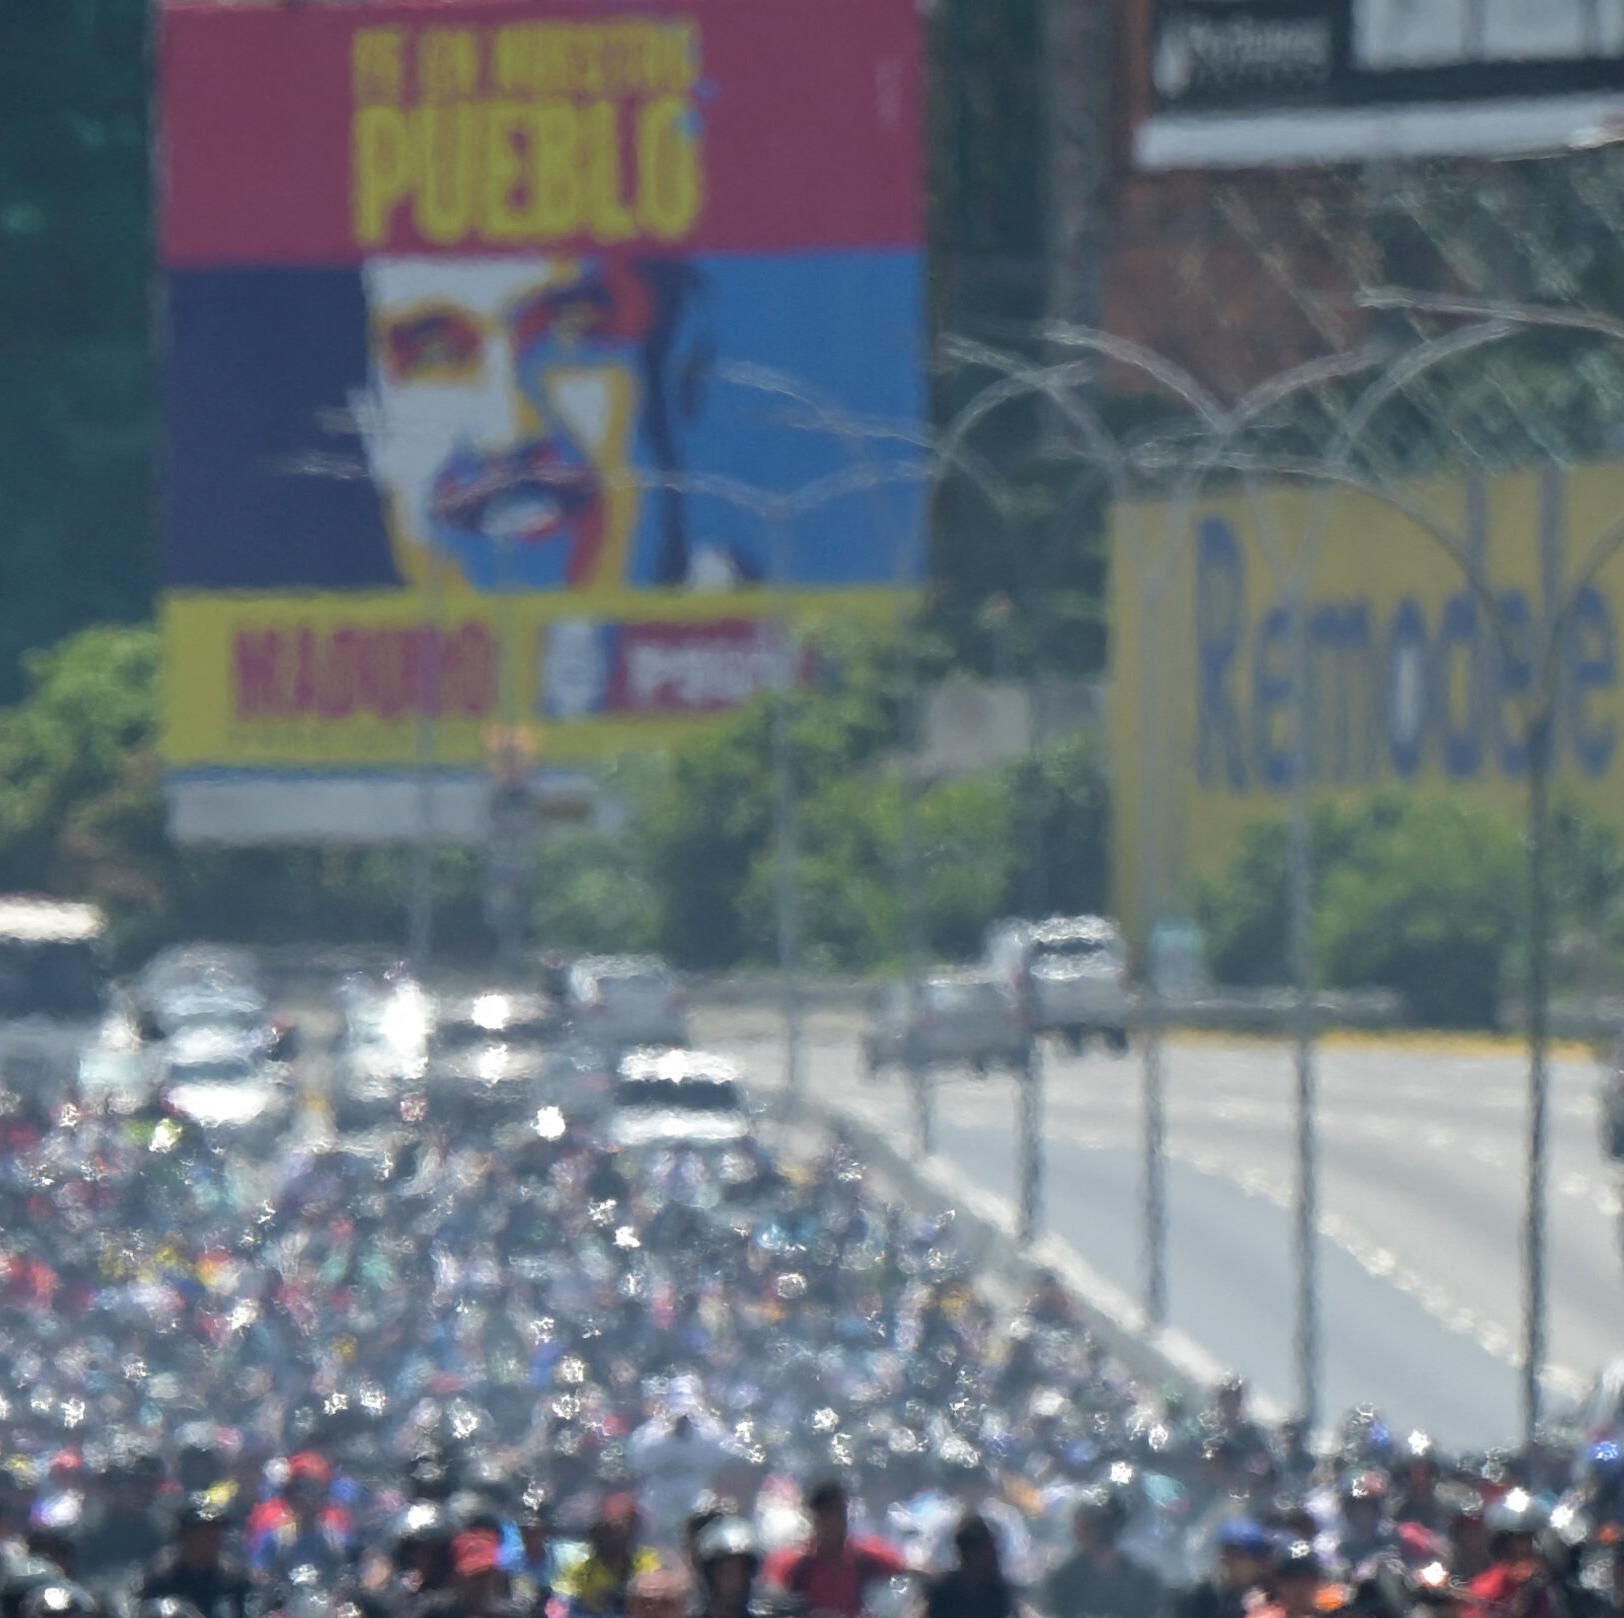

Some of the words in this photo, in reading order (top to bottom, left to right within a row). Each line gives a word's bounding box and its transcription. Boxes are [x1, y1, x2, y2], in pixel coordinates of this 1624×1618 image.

[354, 102, 705, 246] PUEBLO
[233, 622, 493, 722] MADURO
[1193, 516, 1619, 798] Remodele
